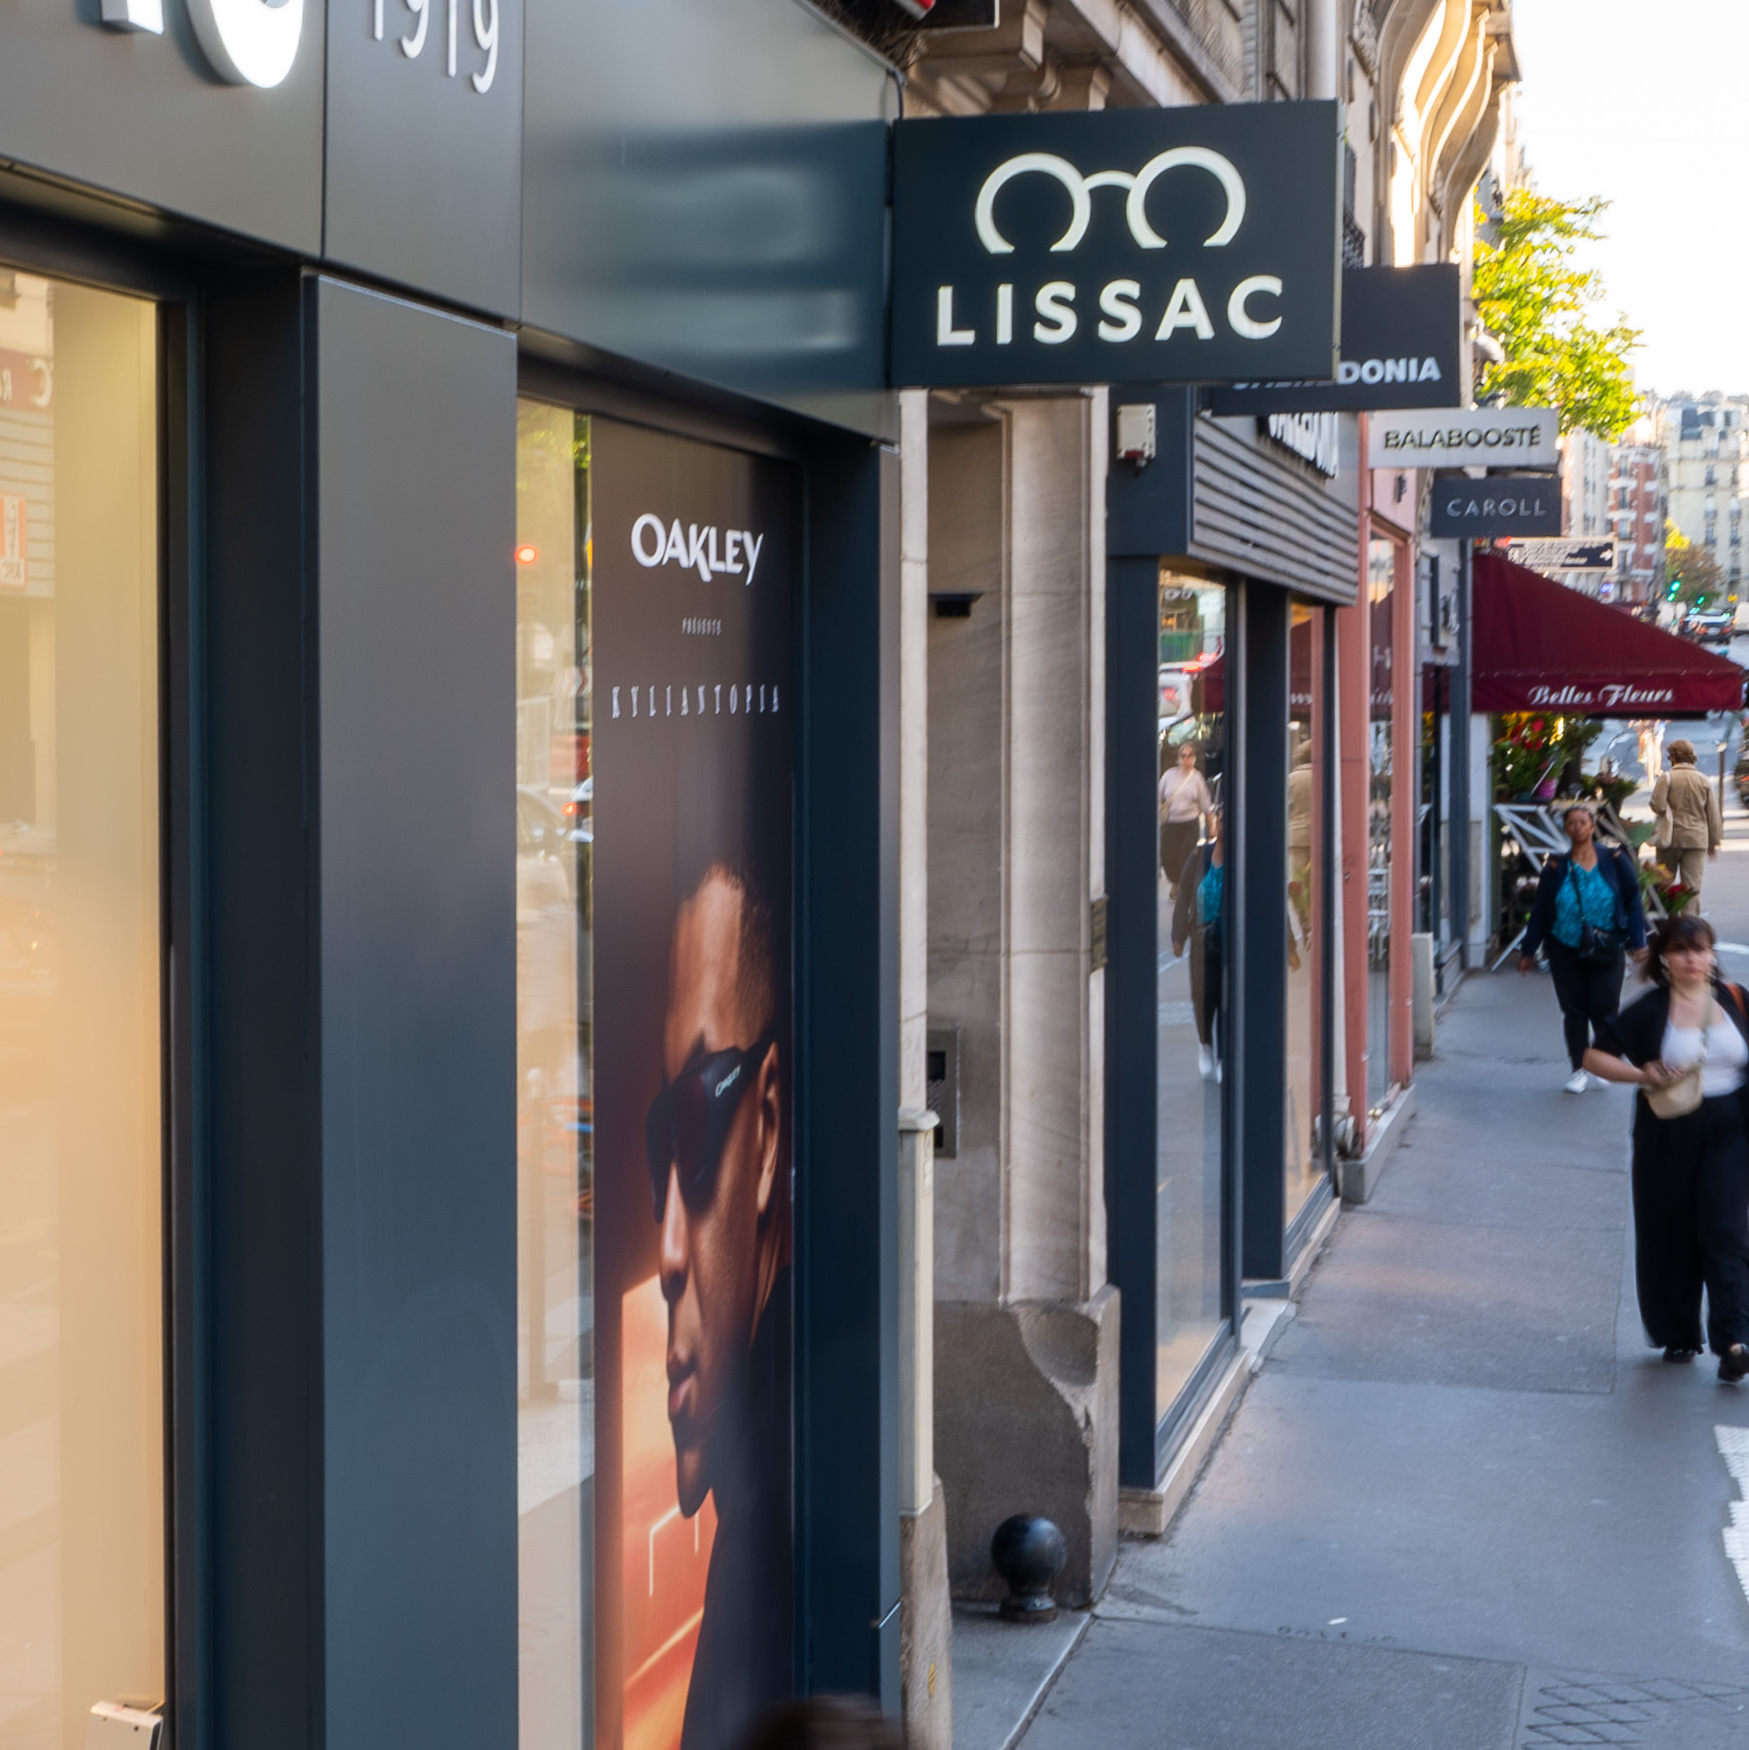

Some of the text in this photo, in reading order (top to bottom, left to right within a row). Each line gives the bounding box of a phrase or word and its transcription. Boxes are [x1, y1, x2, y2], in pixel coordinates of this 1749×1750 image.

[936, 275, 1284, 347] LISSAC
[1384, 423, 1543, 451] BALABOOSTÉ
[1446, 497, 1547, 518] CAROLL
[630, 512, 764, 586] OAKLEY
[1527, 683, 1674, 708] Belles Fleurs
